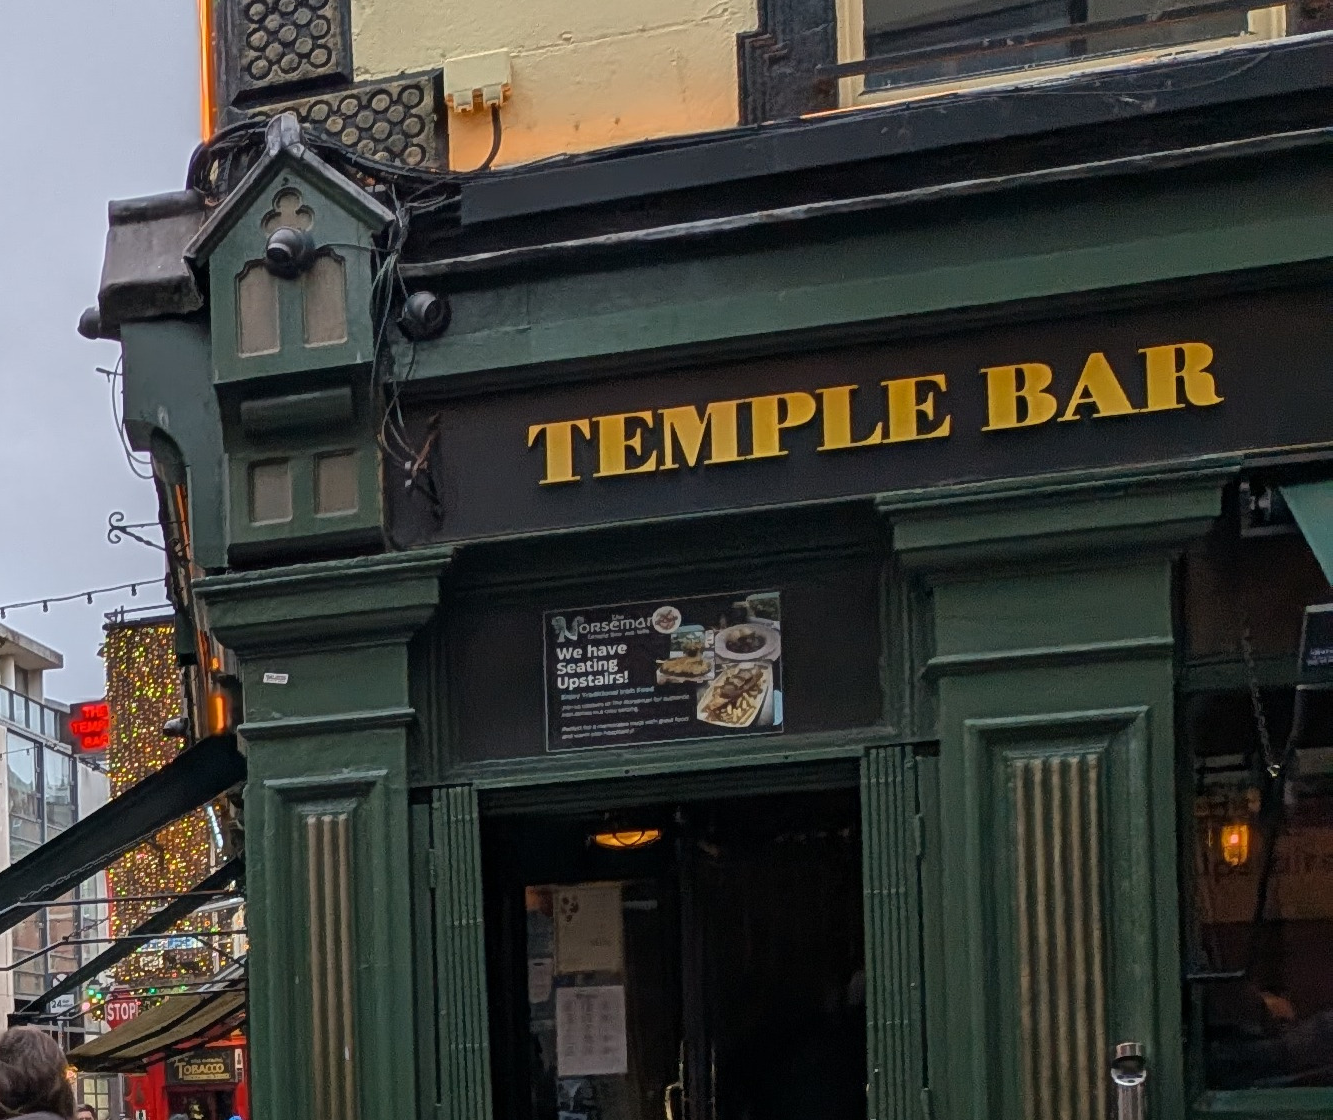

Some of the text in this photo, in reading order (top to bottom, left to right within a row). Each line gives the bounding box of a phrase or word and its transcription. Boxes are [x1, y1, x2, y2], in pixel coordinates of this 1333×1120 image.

[528, 341, 1225, 486] TEMPLE BAR
[556, 644, 628, 660] We have
[556, 659, 618, 675] Seating
[557, 670, 629, 690] Upstairs!
[107, 1003, 137, 1022] STOP
[175, 1061, 225, 1079] TOBACCO
